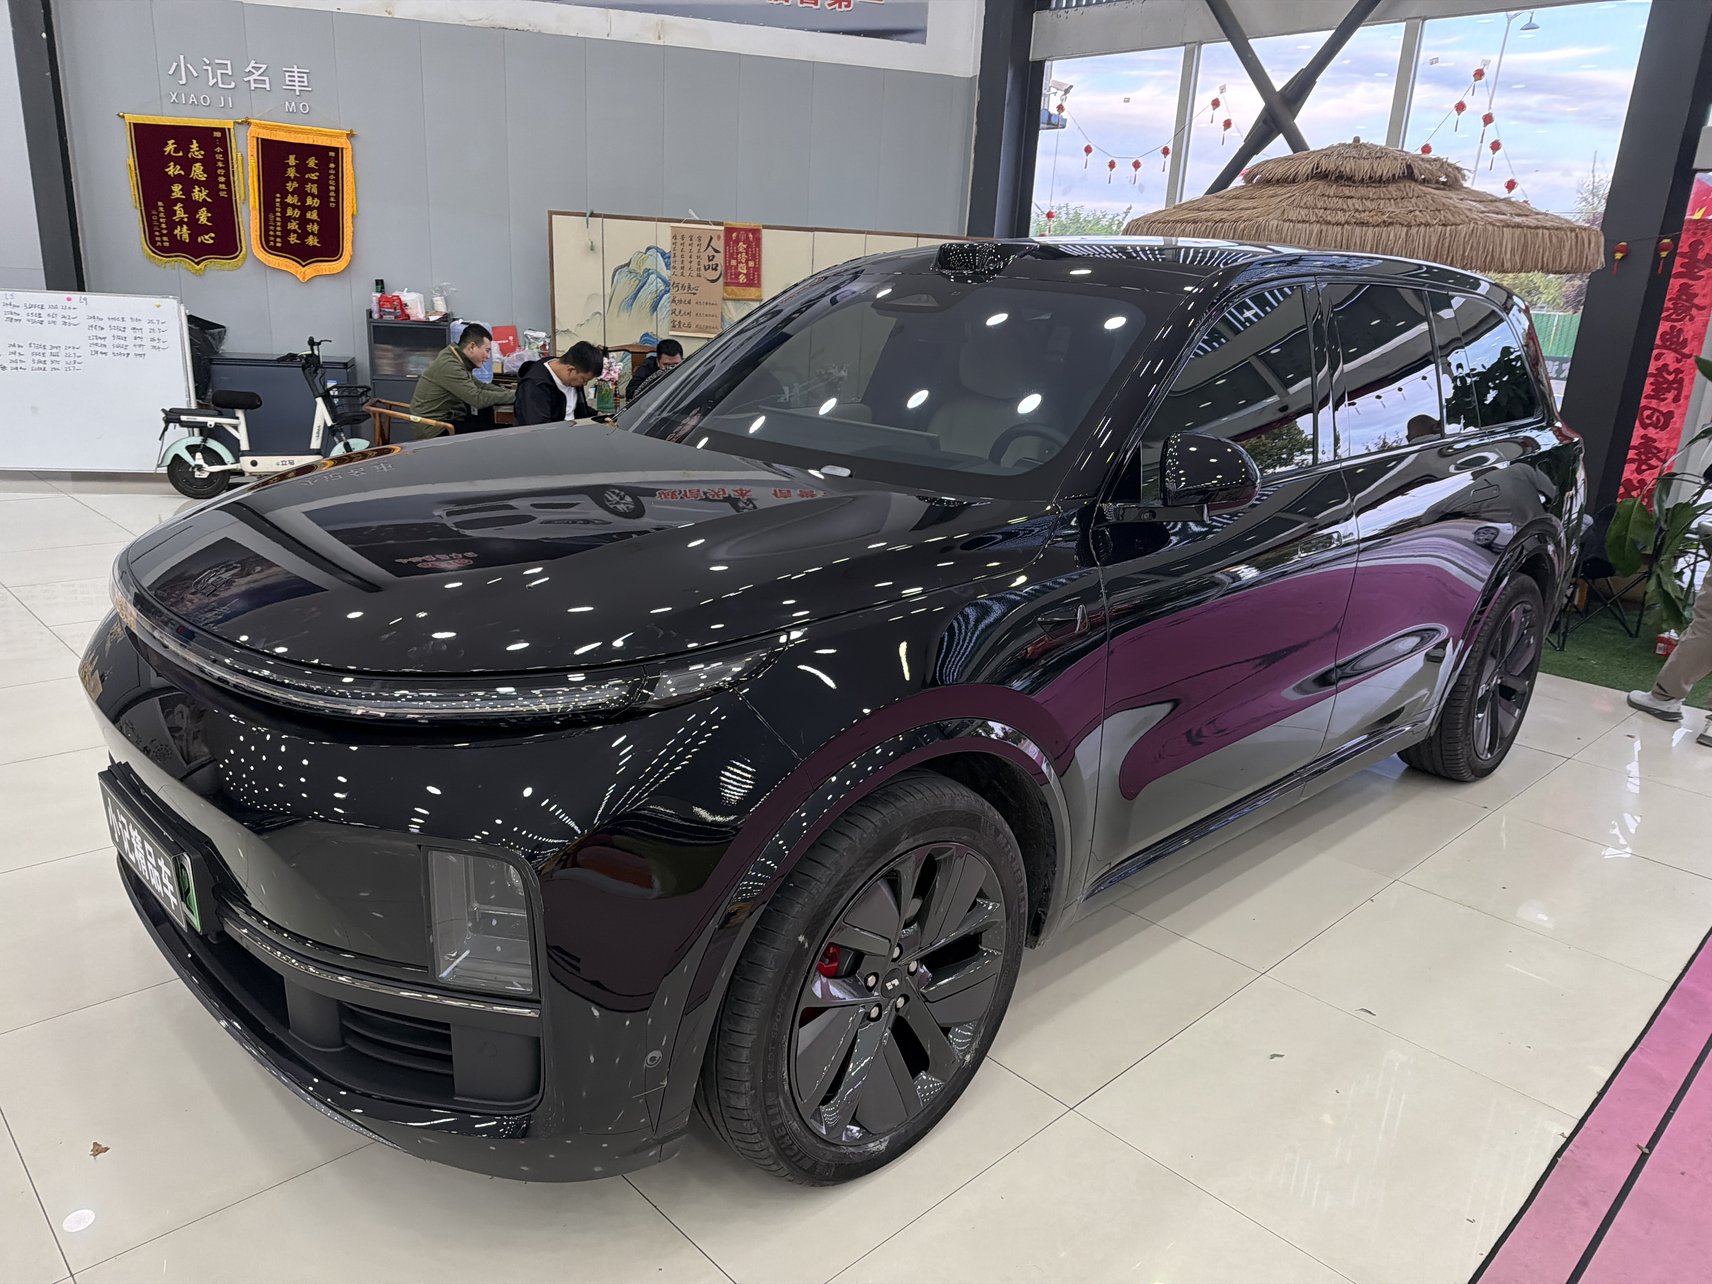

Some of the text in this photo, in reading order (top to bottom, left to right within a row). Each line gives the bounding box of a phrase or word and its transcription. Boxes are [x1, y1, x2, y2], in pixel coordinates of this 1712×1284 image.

[167, 54, 313, 96] 小记名車
[169, 91, 310, 114] XIAO JI MO
[163, 139, 191, 244] 无私显真情
[188, 139, 216, 245] 志愿献爱心
[703, 235, 721, 271] 人品
[107, 797, 178, 911] 小记精品车
[770, 996, 788, 1042] SPORT
